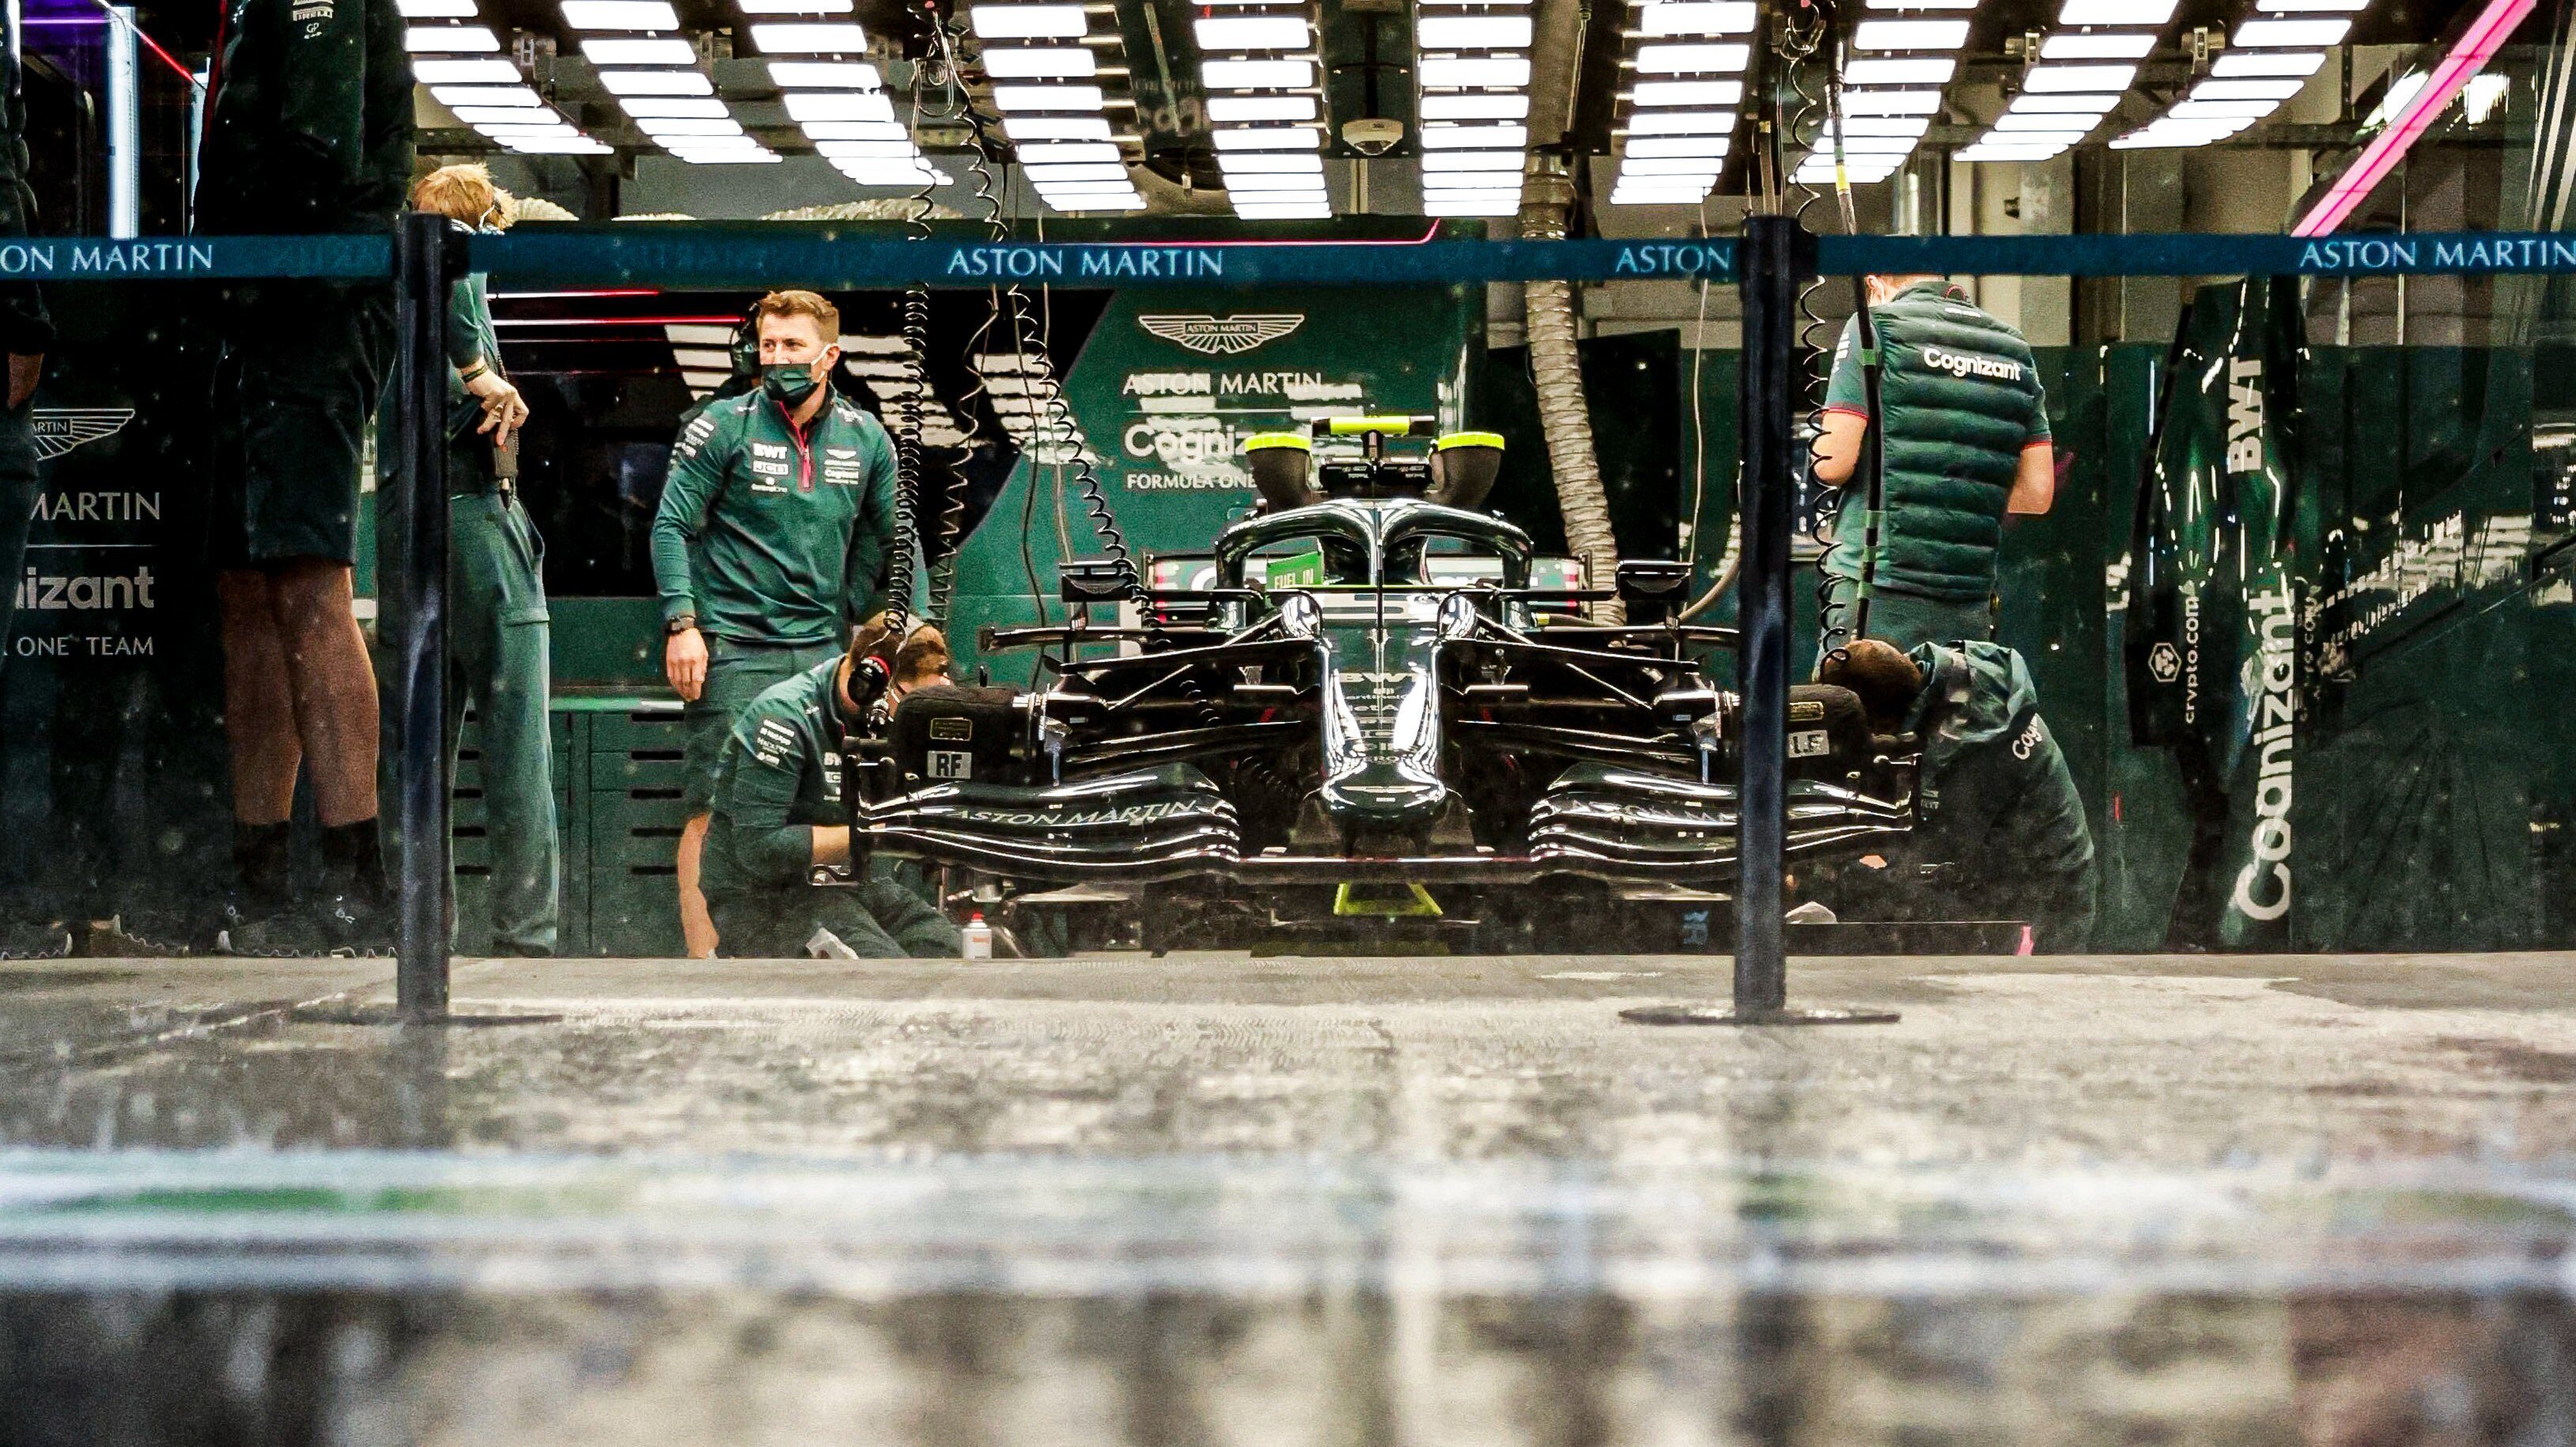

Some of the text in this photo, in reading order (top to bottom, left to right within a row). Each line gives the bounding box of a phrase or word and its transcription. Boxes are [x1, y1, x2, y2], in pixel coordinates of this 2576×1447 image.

[71, 244, 213, 272] MARTIN
[948, 247, 1223, 276] ASTON MARTIN
[1615, 245, 1731, 274] ASTON
[2299, 240, 2576, 269] ASTON MARTIN
[1187, 323, 1256, 334] ASTON MARTIN
[1923, 347, 2022, 381] Cognizant
[1123, 372, 1322, 395] ASTON MARTIN
[2227, 356, 2262, 474] BWT
[1126, 474, 1212, 489] FORMULA
[1274, 568, 1314, 590] FUEL IN
[17, 636, 154, 656] ONE TEAM
[2185, 595, 2200, 725] crypto.com
[936, 753, 963, 777] RF
[2235, 589, 2294, 921] Cognizant
[1065, 799, 1197, 825] MARTIN
